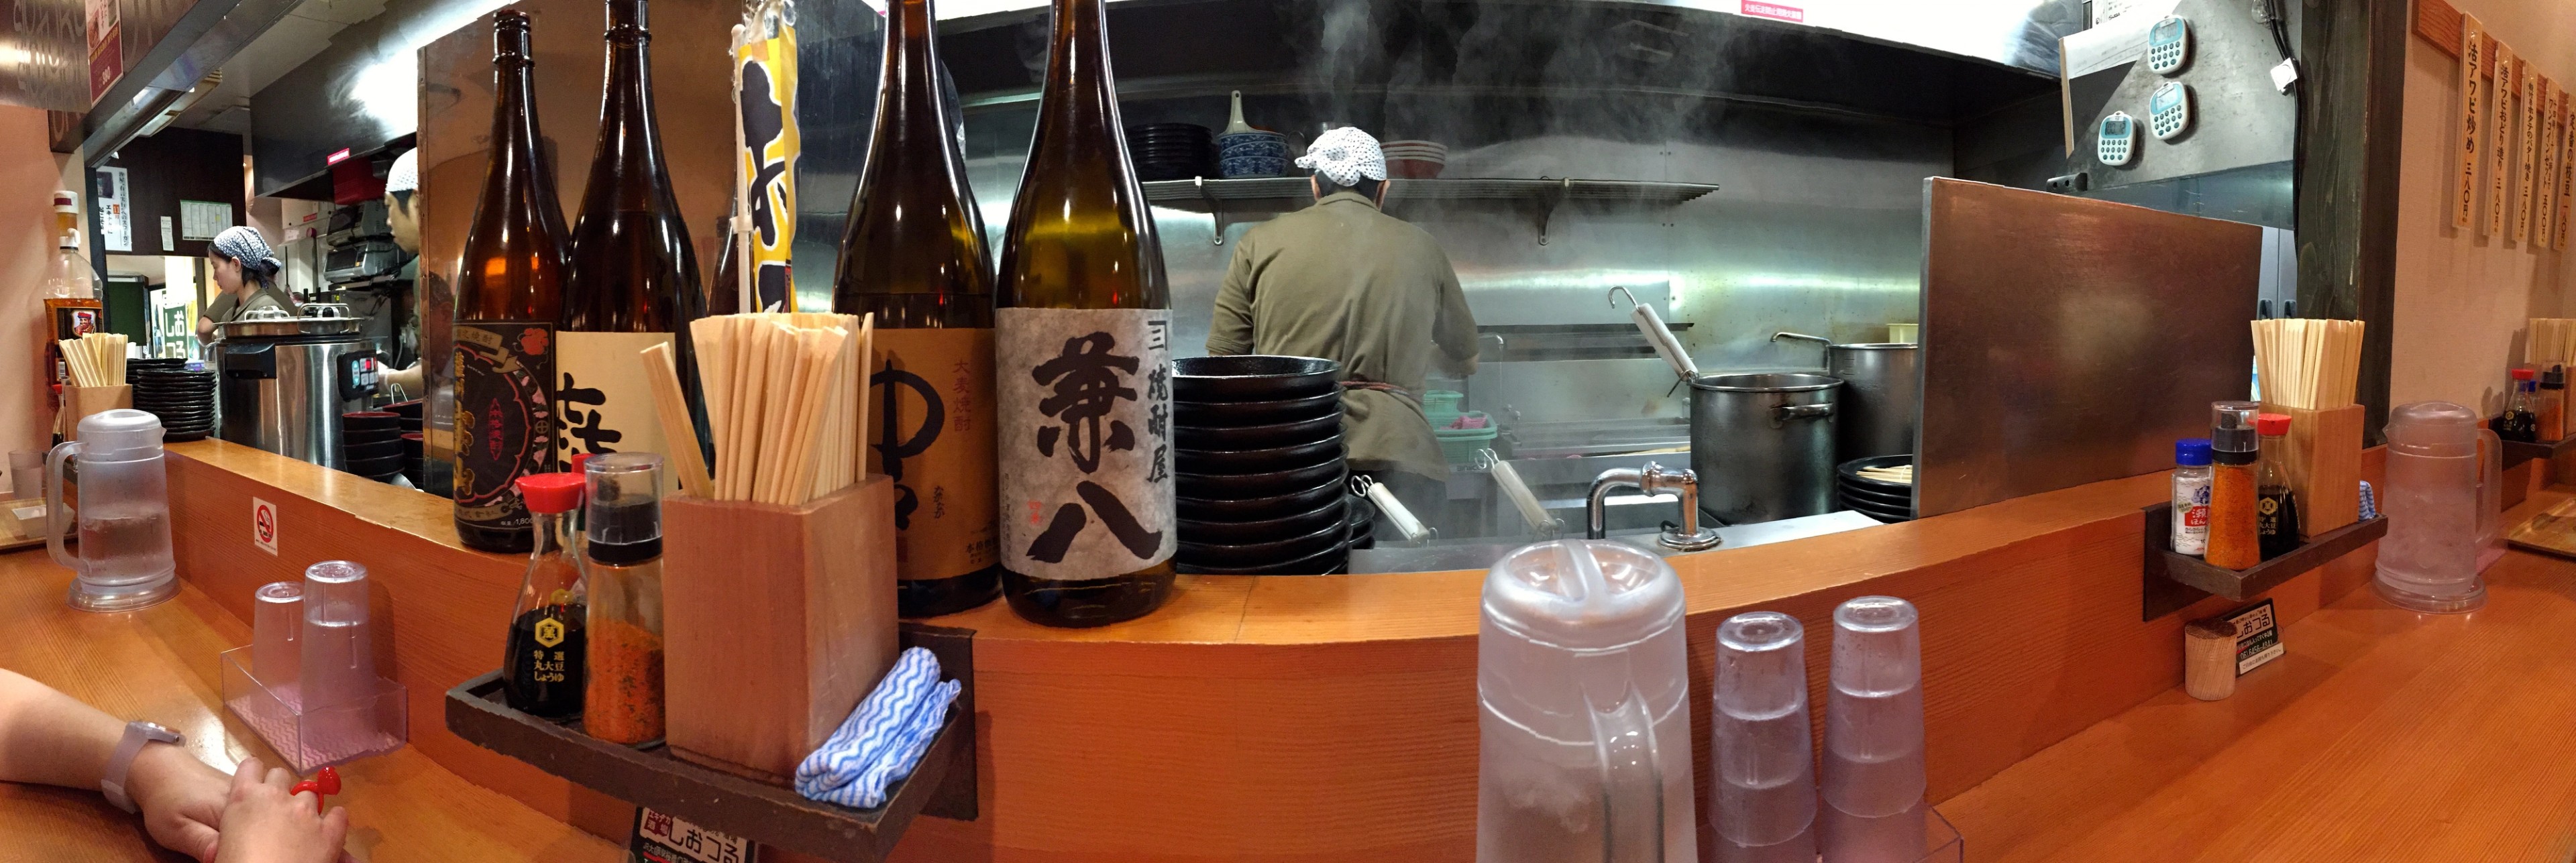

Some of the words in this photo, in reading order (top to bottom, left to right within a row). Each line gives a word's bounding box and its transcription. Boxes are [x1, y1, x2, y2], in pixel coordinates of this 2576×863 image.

[2466, 42, 2478, 154] 活アワビ炒め
[2498, 65, 2510, 171] 活アワビおどり造り
[2543, 99, 2553, 188] ワンコインセット
[2564, 113, 2576, 196] 定番の枝豆
[953, 359, 972, 432] 大麦焼酎
[1147, 363, 1169, 484] 焼酎屋
[1026, 331, 1163, 564] 兼八
[534, 660, 564, 671] 丸大豆
[534, 671, 564, 682] しょうゆ
[668, 820, 739, 863] しおつる
